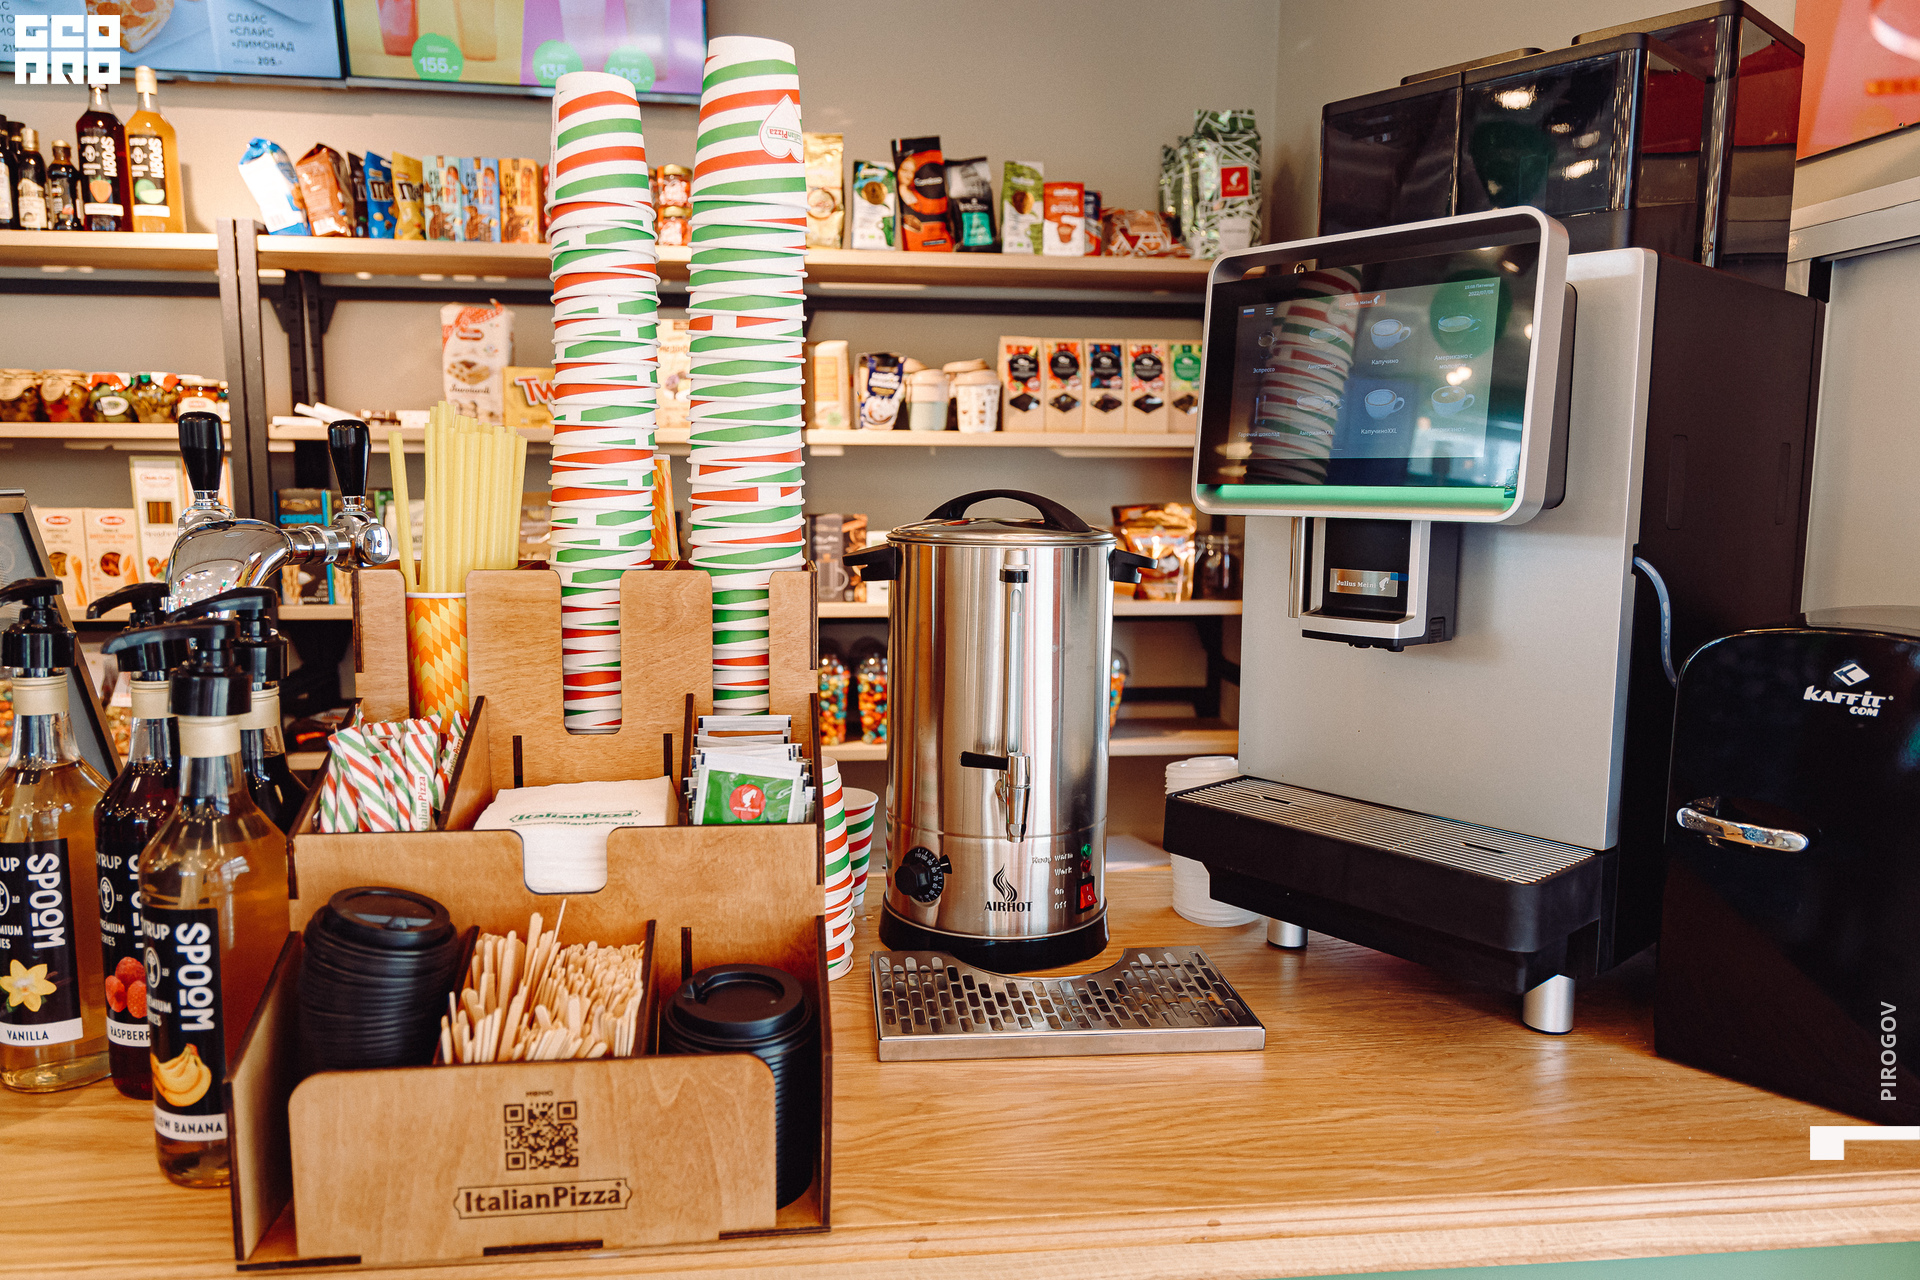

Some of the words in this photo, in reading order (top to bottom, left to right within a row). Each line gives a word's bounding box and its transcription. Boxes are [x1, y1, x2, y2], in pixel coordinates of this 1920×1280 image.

[540, 63, 568, 80] 135
[1371, 358, 1399, 366] Капучино
[1434, 354, 1466, 362] Американо
[1849, 706, 1879, 717] COM
[1054, 853, 1073, 862] warm
[1054, 867, 1072, 876] Work
[26, 852, 66, 949] SPOOM
[1054, 901, 1067, 910] Off
[984, 901, 1033, 912] AIRHOT
[175, 922, 215, 1031] SPOOM
[6, 1029, 49, 1041] VANILLA
[110, 1025, 151, 1041] RASPBERR
[174, 1122, 223, 1133] BANANA
[464, 1184, 621, 1213] ItalianPizza
